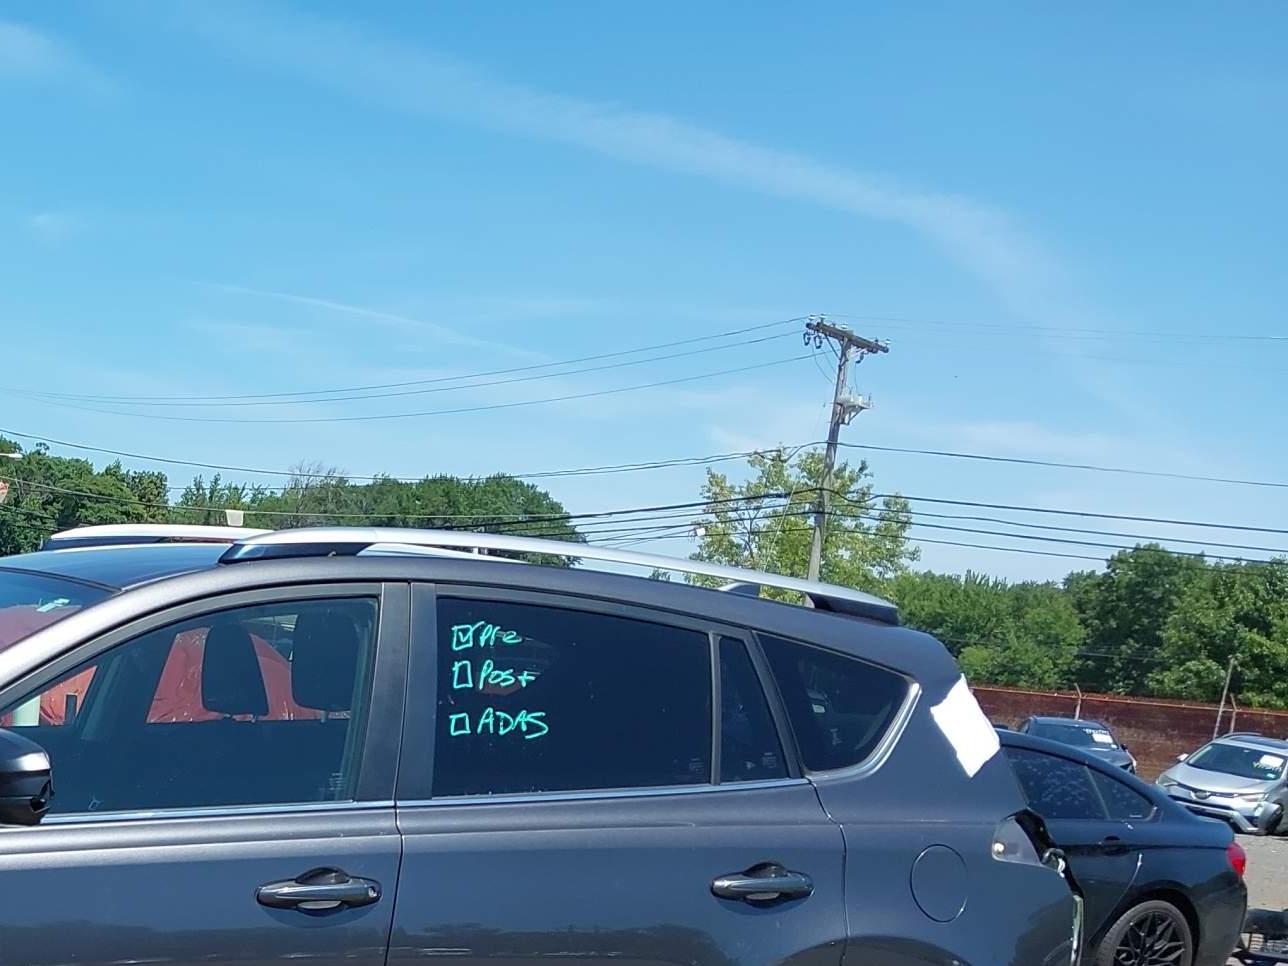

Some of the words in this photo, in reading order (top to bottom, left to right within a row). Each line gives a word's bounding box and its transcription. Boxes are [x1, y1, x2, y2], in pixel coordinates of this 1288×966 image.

[479, 623, 523, 648] Pre
[478, 659, 536, 690] Post
[476, 707, 549, 739] ADAS
